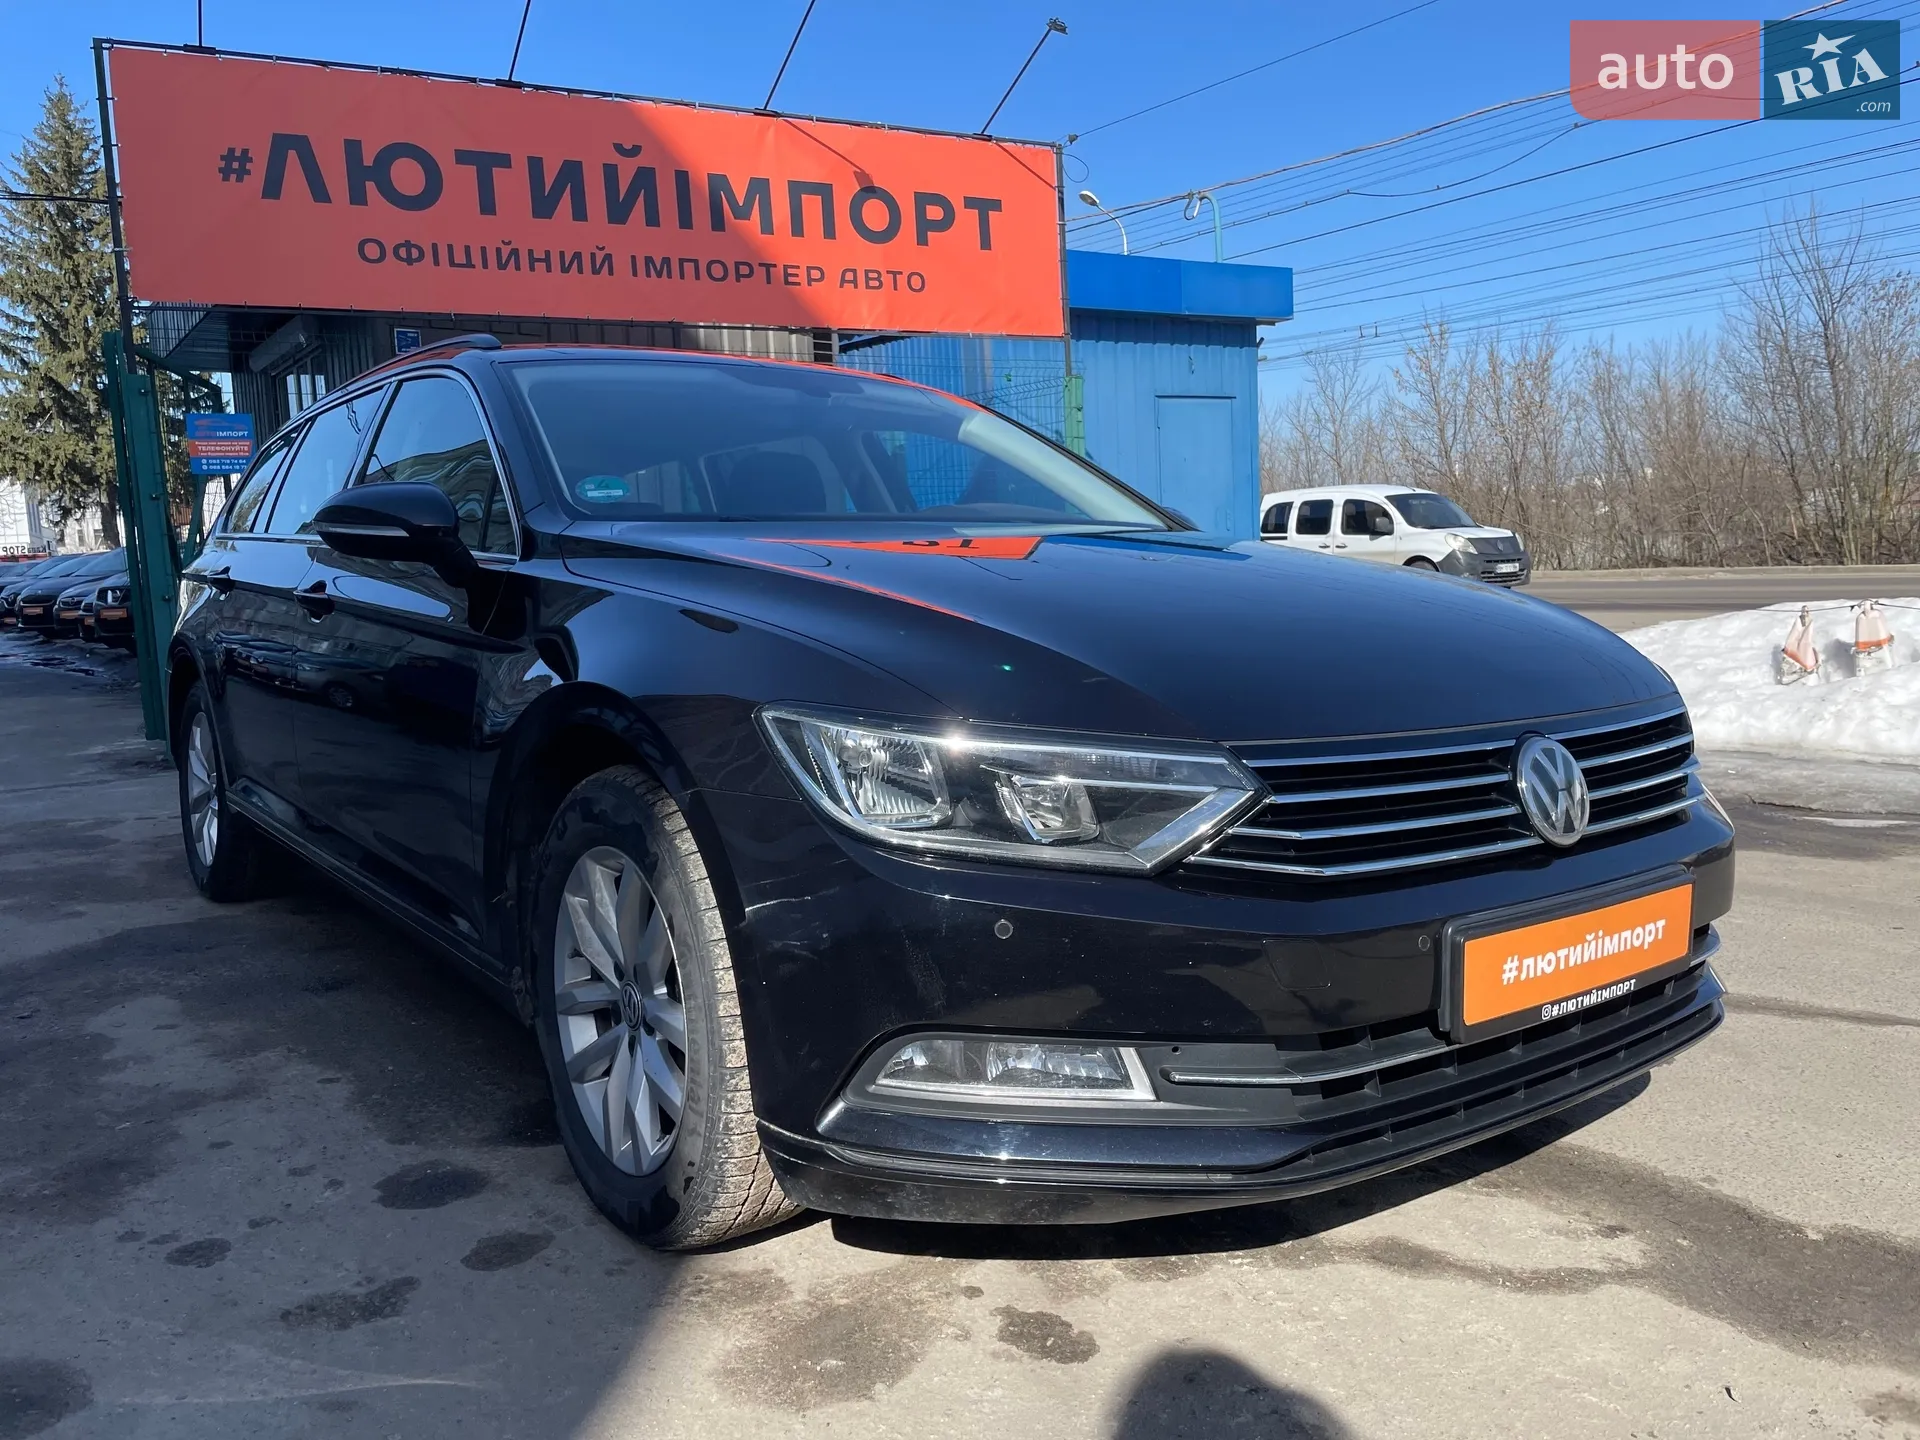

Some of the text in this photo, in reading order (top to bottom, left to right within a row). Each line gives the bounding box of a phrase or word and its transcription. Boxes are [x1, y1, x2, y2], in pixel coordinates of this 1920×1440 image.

[217, 132, 1003, 251] #ЛЮТИЙІМПОРТ
[357, 238, 927, 294] ОФІЦІЙНИЙ ІМПОРТЕР АВТО
[1502, 919, 1666, 985] #лютийімпорт
